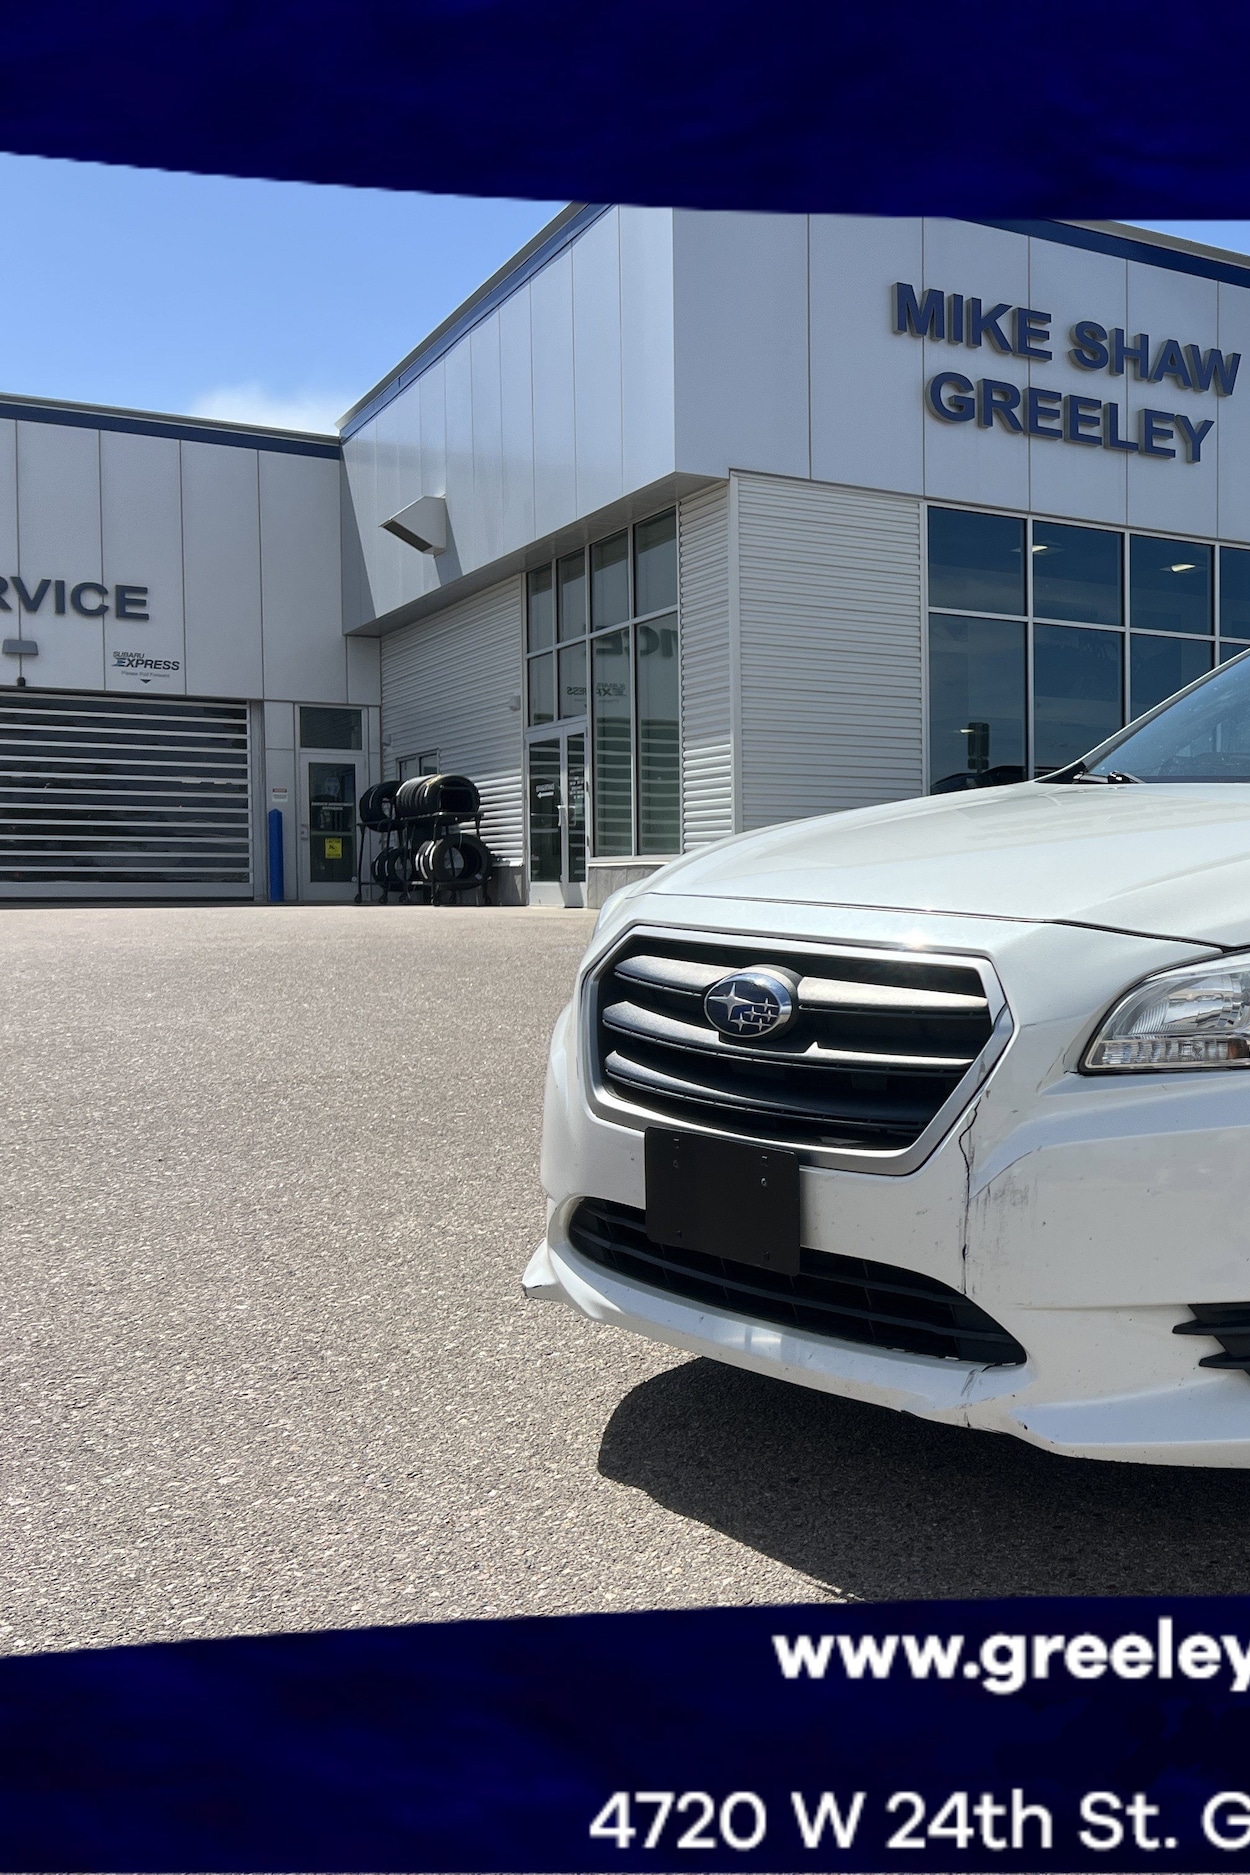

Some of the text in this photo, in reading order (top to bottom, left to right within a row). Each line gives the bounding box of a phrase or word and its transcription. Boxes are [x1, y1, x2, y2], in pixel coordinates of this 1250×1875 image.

[891, 281, 1241, 397] MIKE SHAW
[925, 371, 1215, 464] GREELEY
[112, 658, 180, 671] EXPRESS
[113, 650, 145, 659] SUBARU
